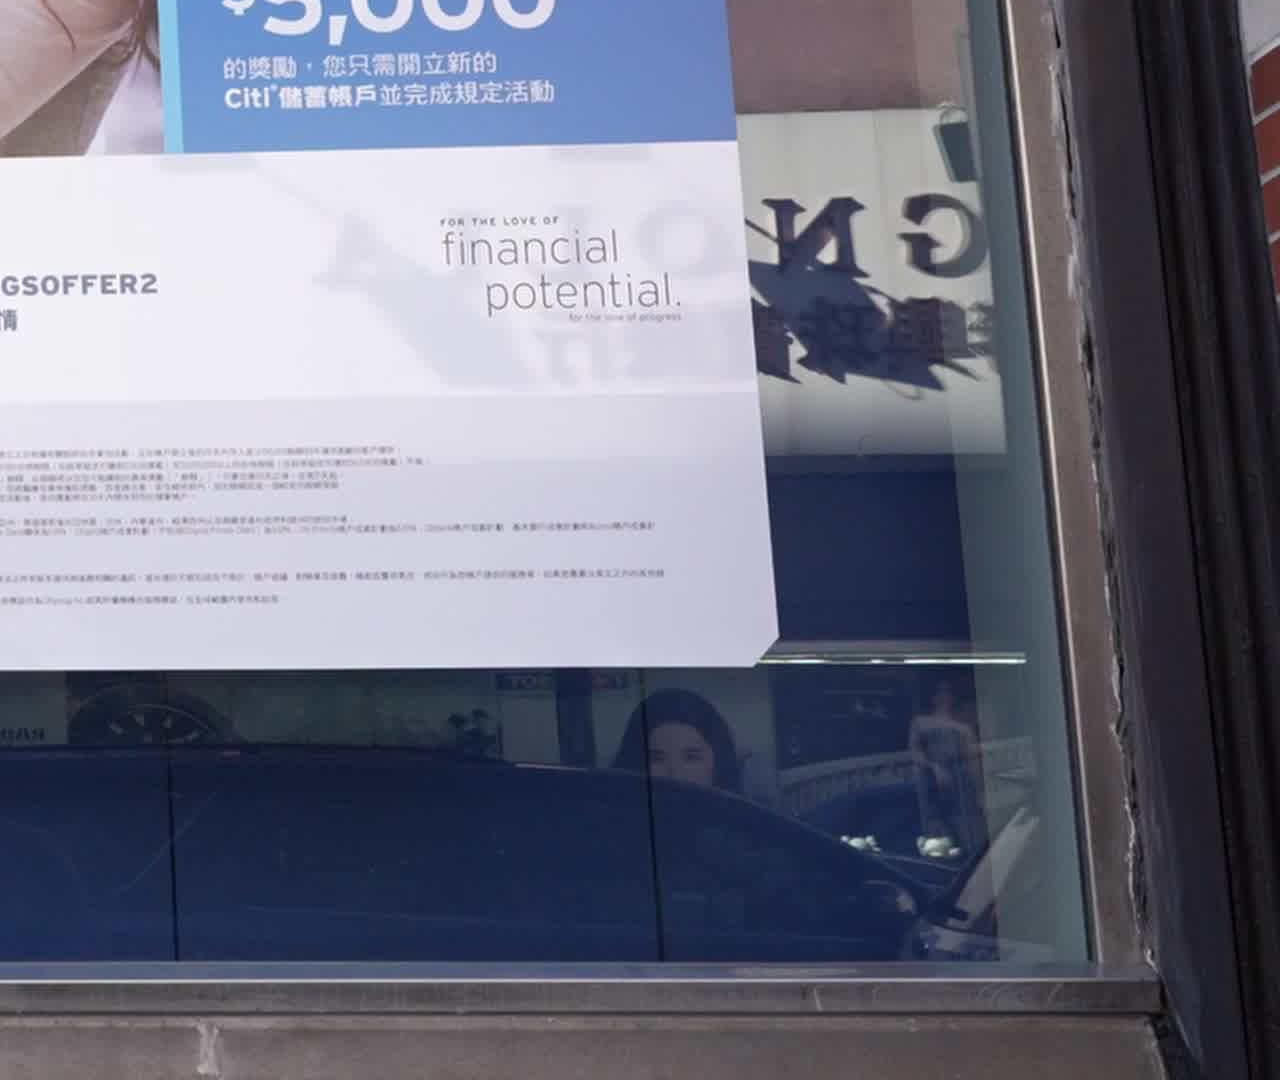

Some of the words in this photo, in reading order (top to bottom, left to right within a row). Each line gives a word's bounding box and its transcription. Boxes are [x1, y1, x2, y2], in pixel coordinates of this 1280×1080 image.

[440, 218, 464, 226] FOR
[472, 218, 496, 226] THE
[504, 216, 536, 226] LOVE
[543, 216, 558, 224] OF
[443, 229, 617, 265] financial
[487, 272, 681, 323] potential.
